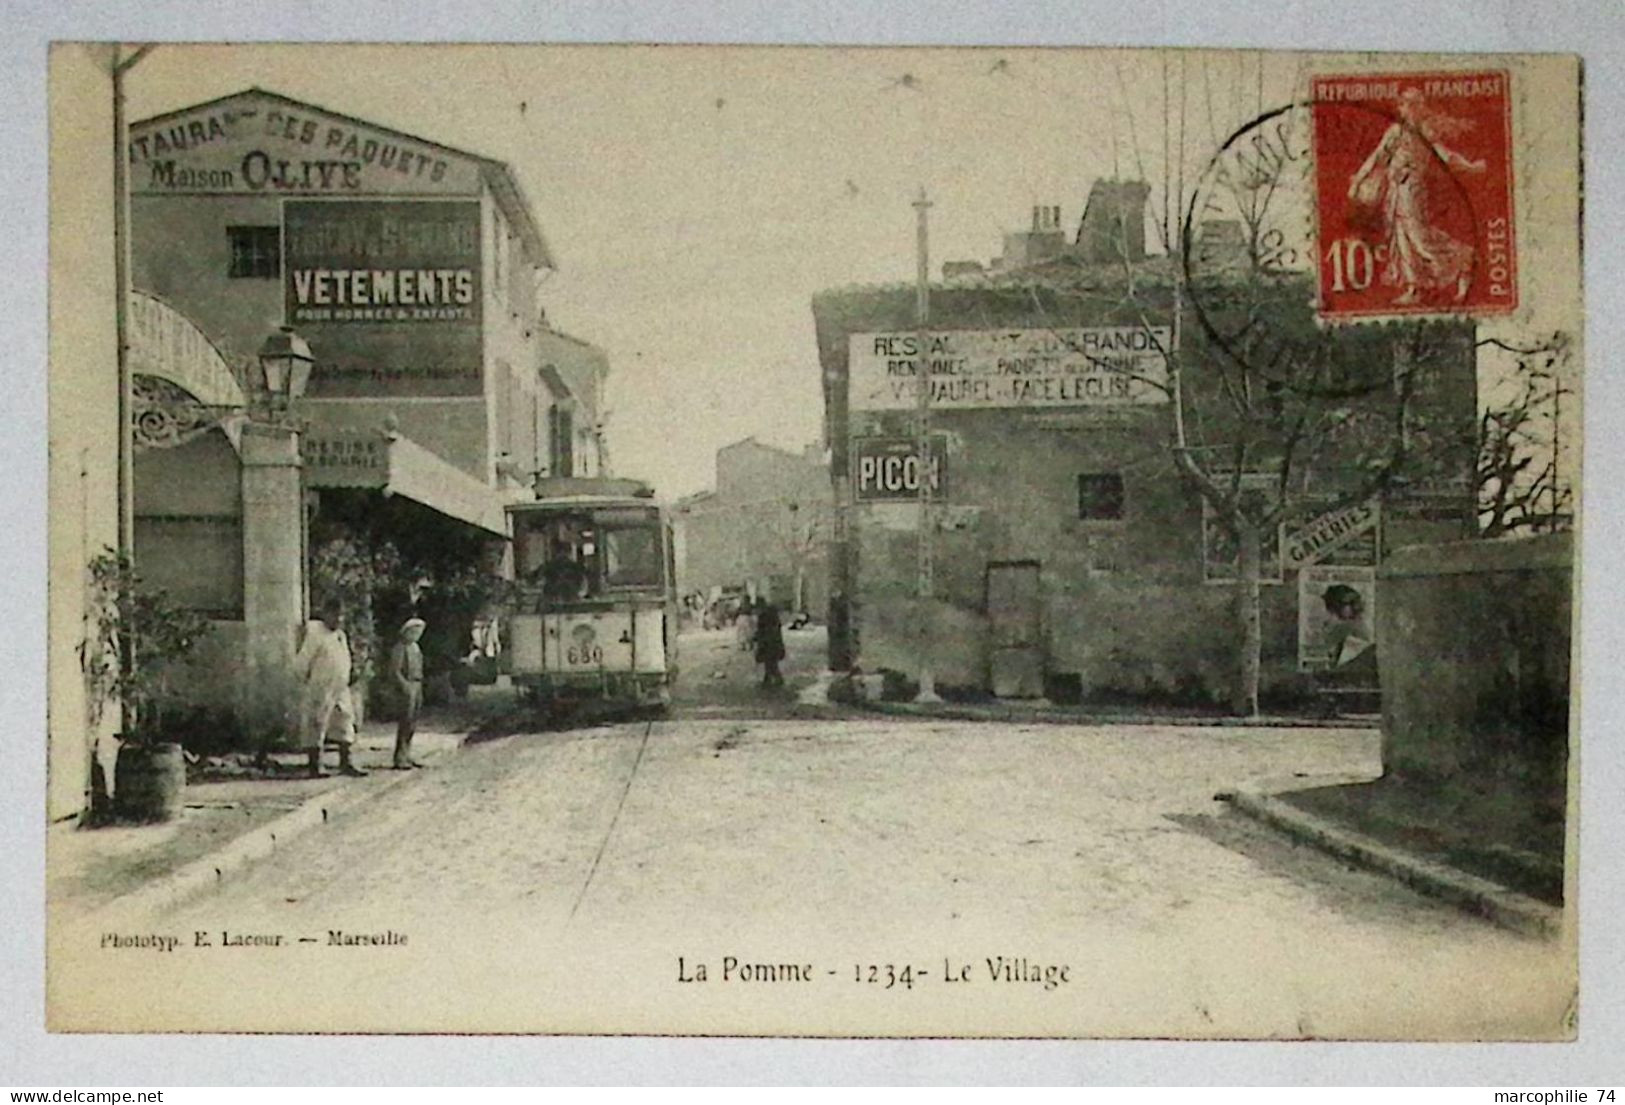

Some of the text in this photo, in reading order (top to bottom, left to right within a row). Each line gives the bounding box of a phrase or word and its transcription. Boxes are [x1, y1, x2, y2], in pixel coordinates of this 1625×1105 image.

[151, 150, 363, 191] Maison OLIVE
[1488, 217, 1507, 297] POSTES
[293, 268, 474, 305] VETEMENTS
[677, 956, 708, 983] La
[722, 956, 814, 983] Pomme
[943, 956, 973, 983] Le
[986, 955, 1072, 991] Village
